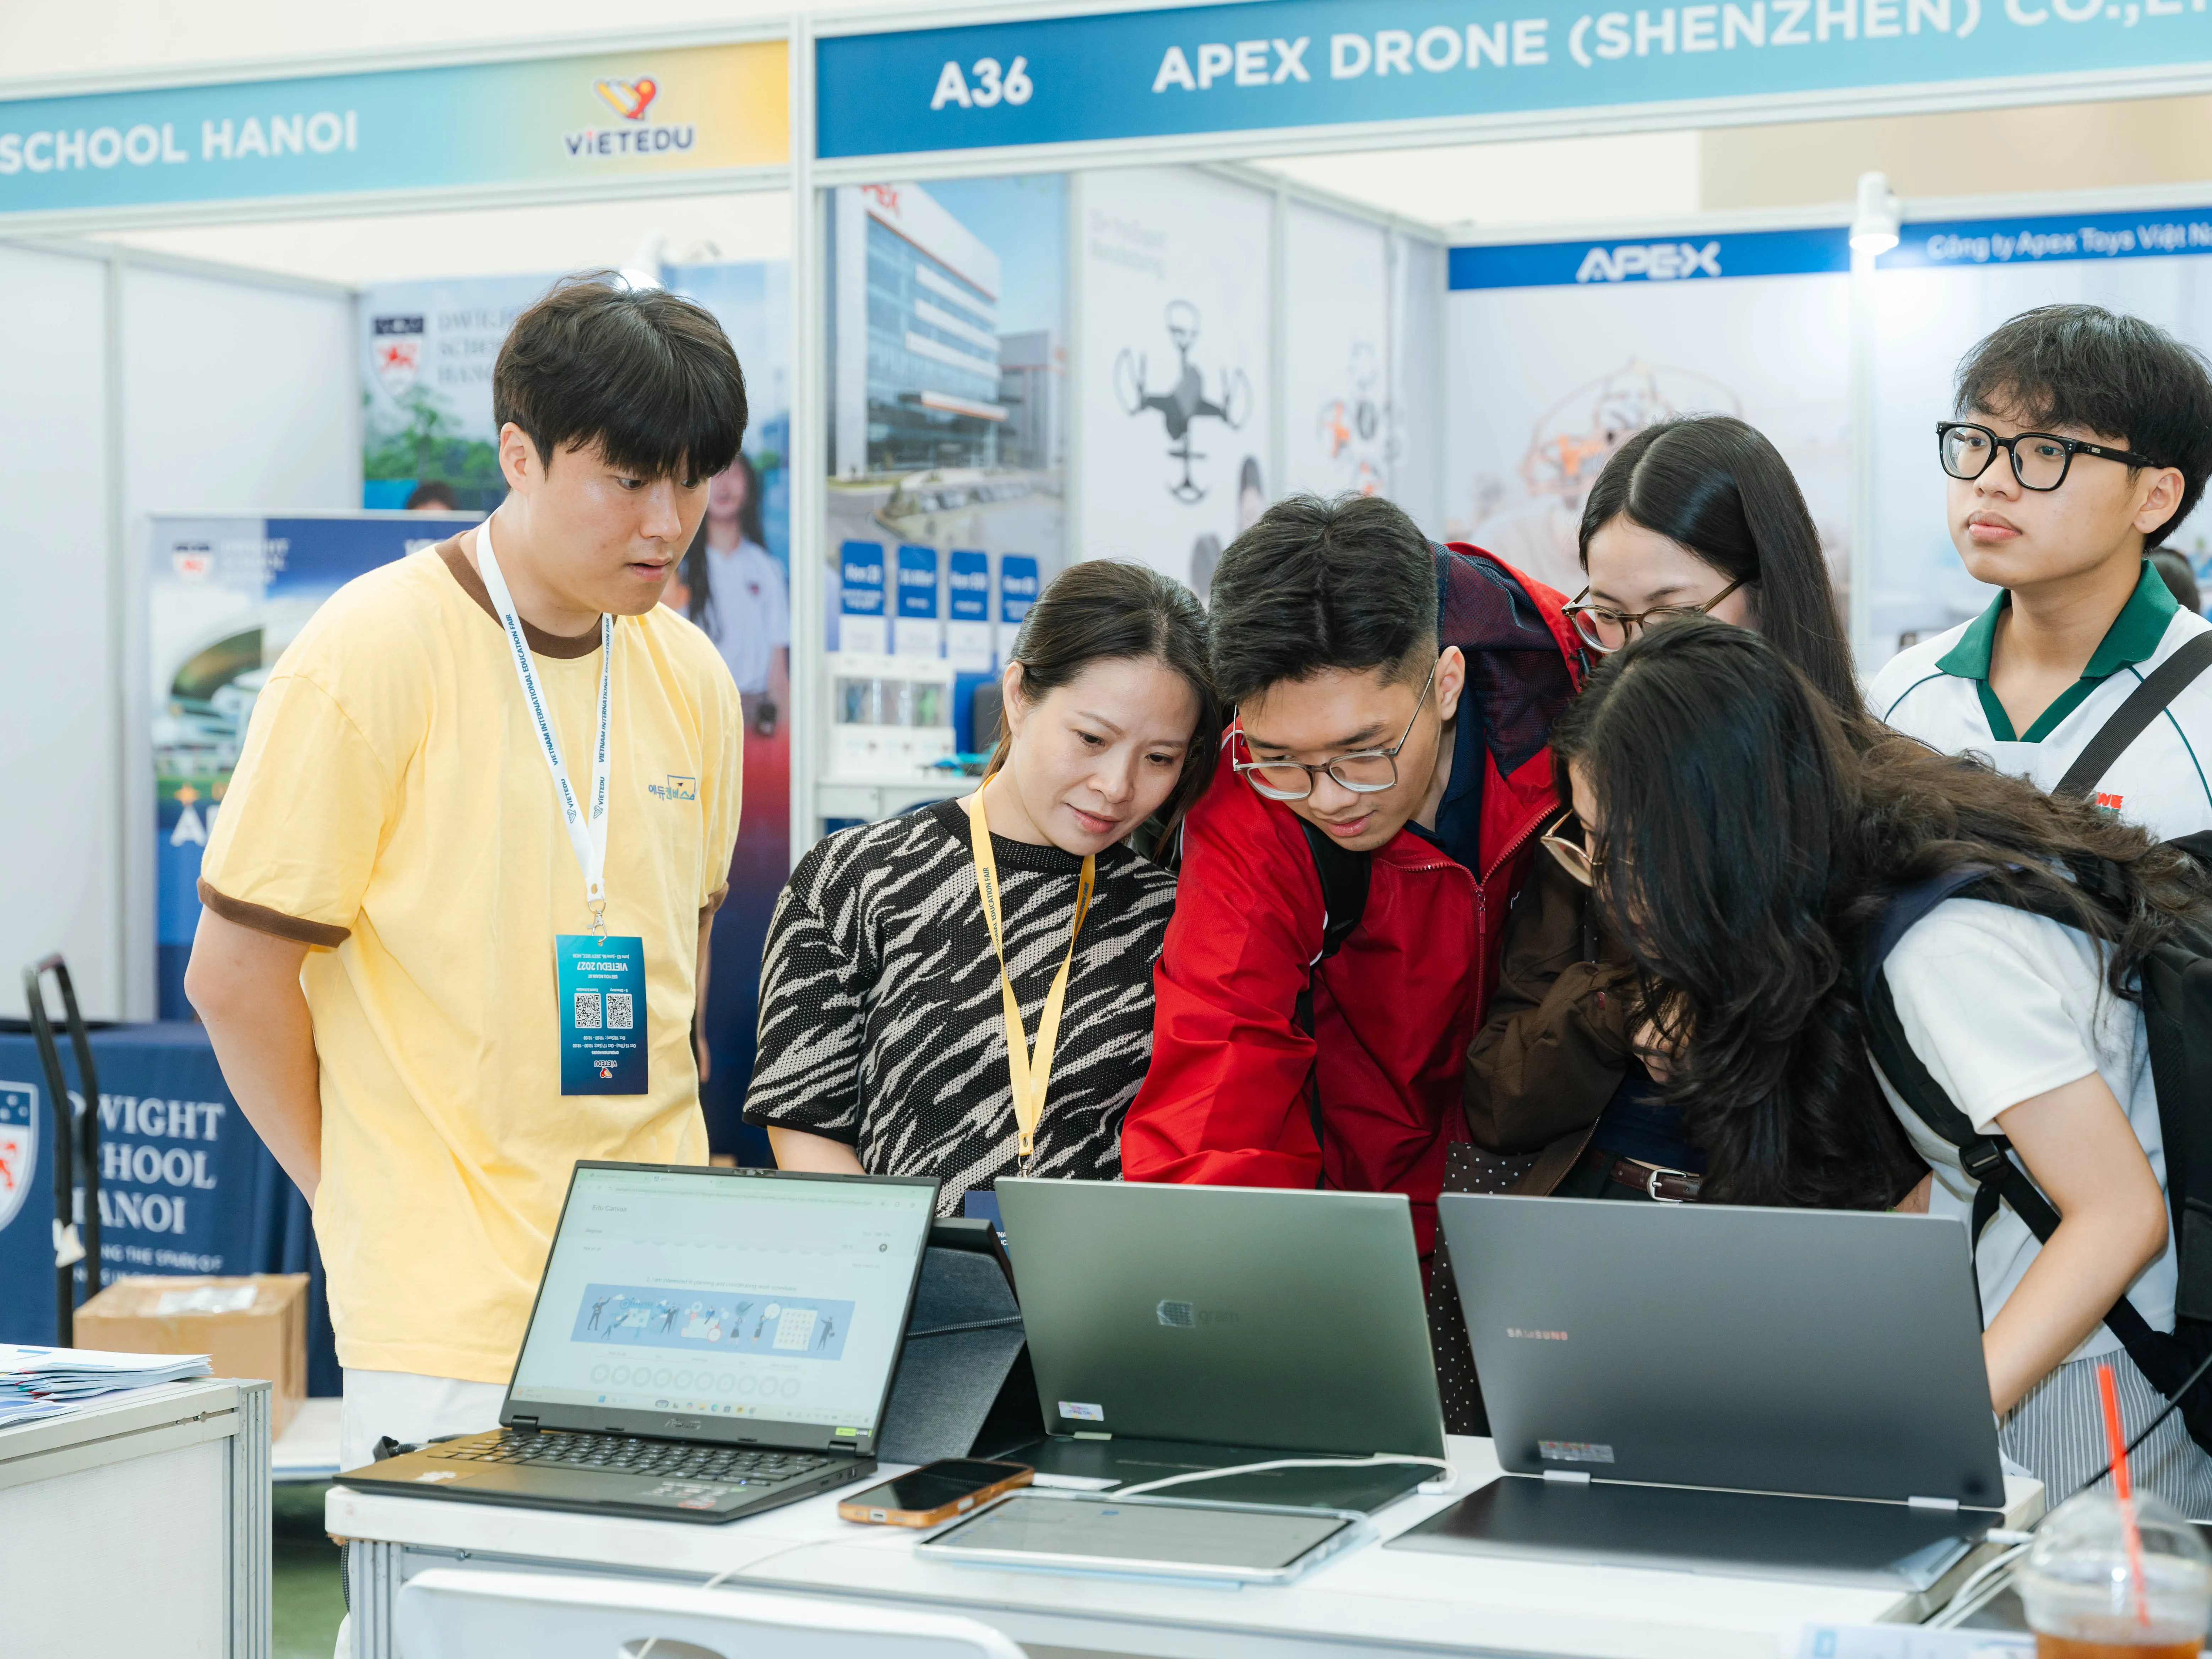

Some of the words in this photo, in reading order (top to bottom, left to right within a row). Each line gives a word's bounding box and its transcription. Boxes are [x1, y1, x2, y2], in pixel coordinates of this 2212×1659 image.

[1152, 36, 1310, 93] APEX
[1330, 19, 1549, 79] DRONE
[1568, 0, 1981, 67] (SHENZHEN)
[930, 56, 1034, 111] A36
[0, 123, 189, 175] SCHOOL
[201, 109, 358, 161] HANOI
[1576, 241, 1722, 283] APEX
[505, 614, 516, 630] FAIR
[512, 631, 529, 672] EDUCATION
[523, 673, 547, 731] INTERNATIONAL
[543, 732, 558, 766] VIETNAM
[985, 883, 996, 921] EDUCATION
[577, 962, 596, 970] 2027
[597, 962, 628, 971] VIETEDU
[102, 1141, 218, 1190] HOOL
